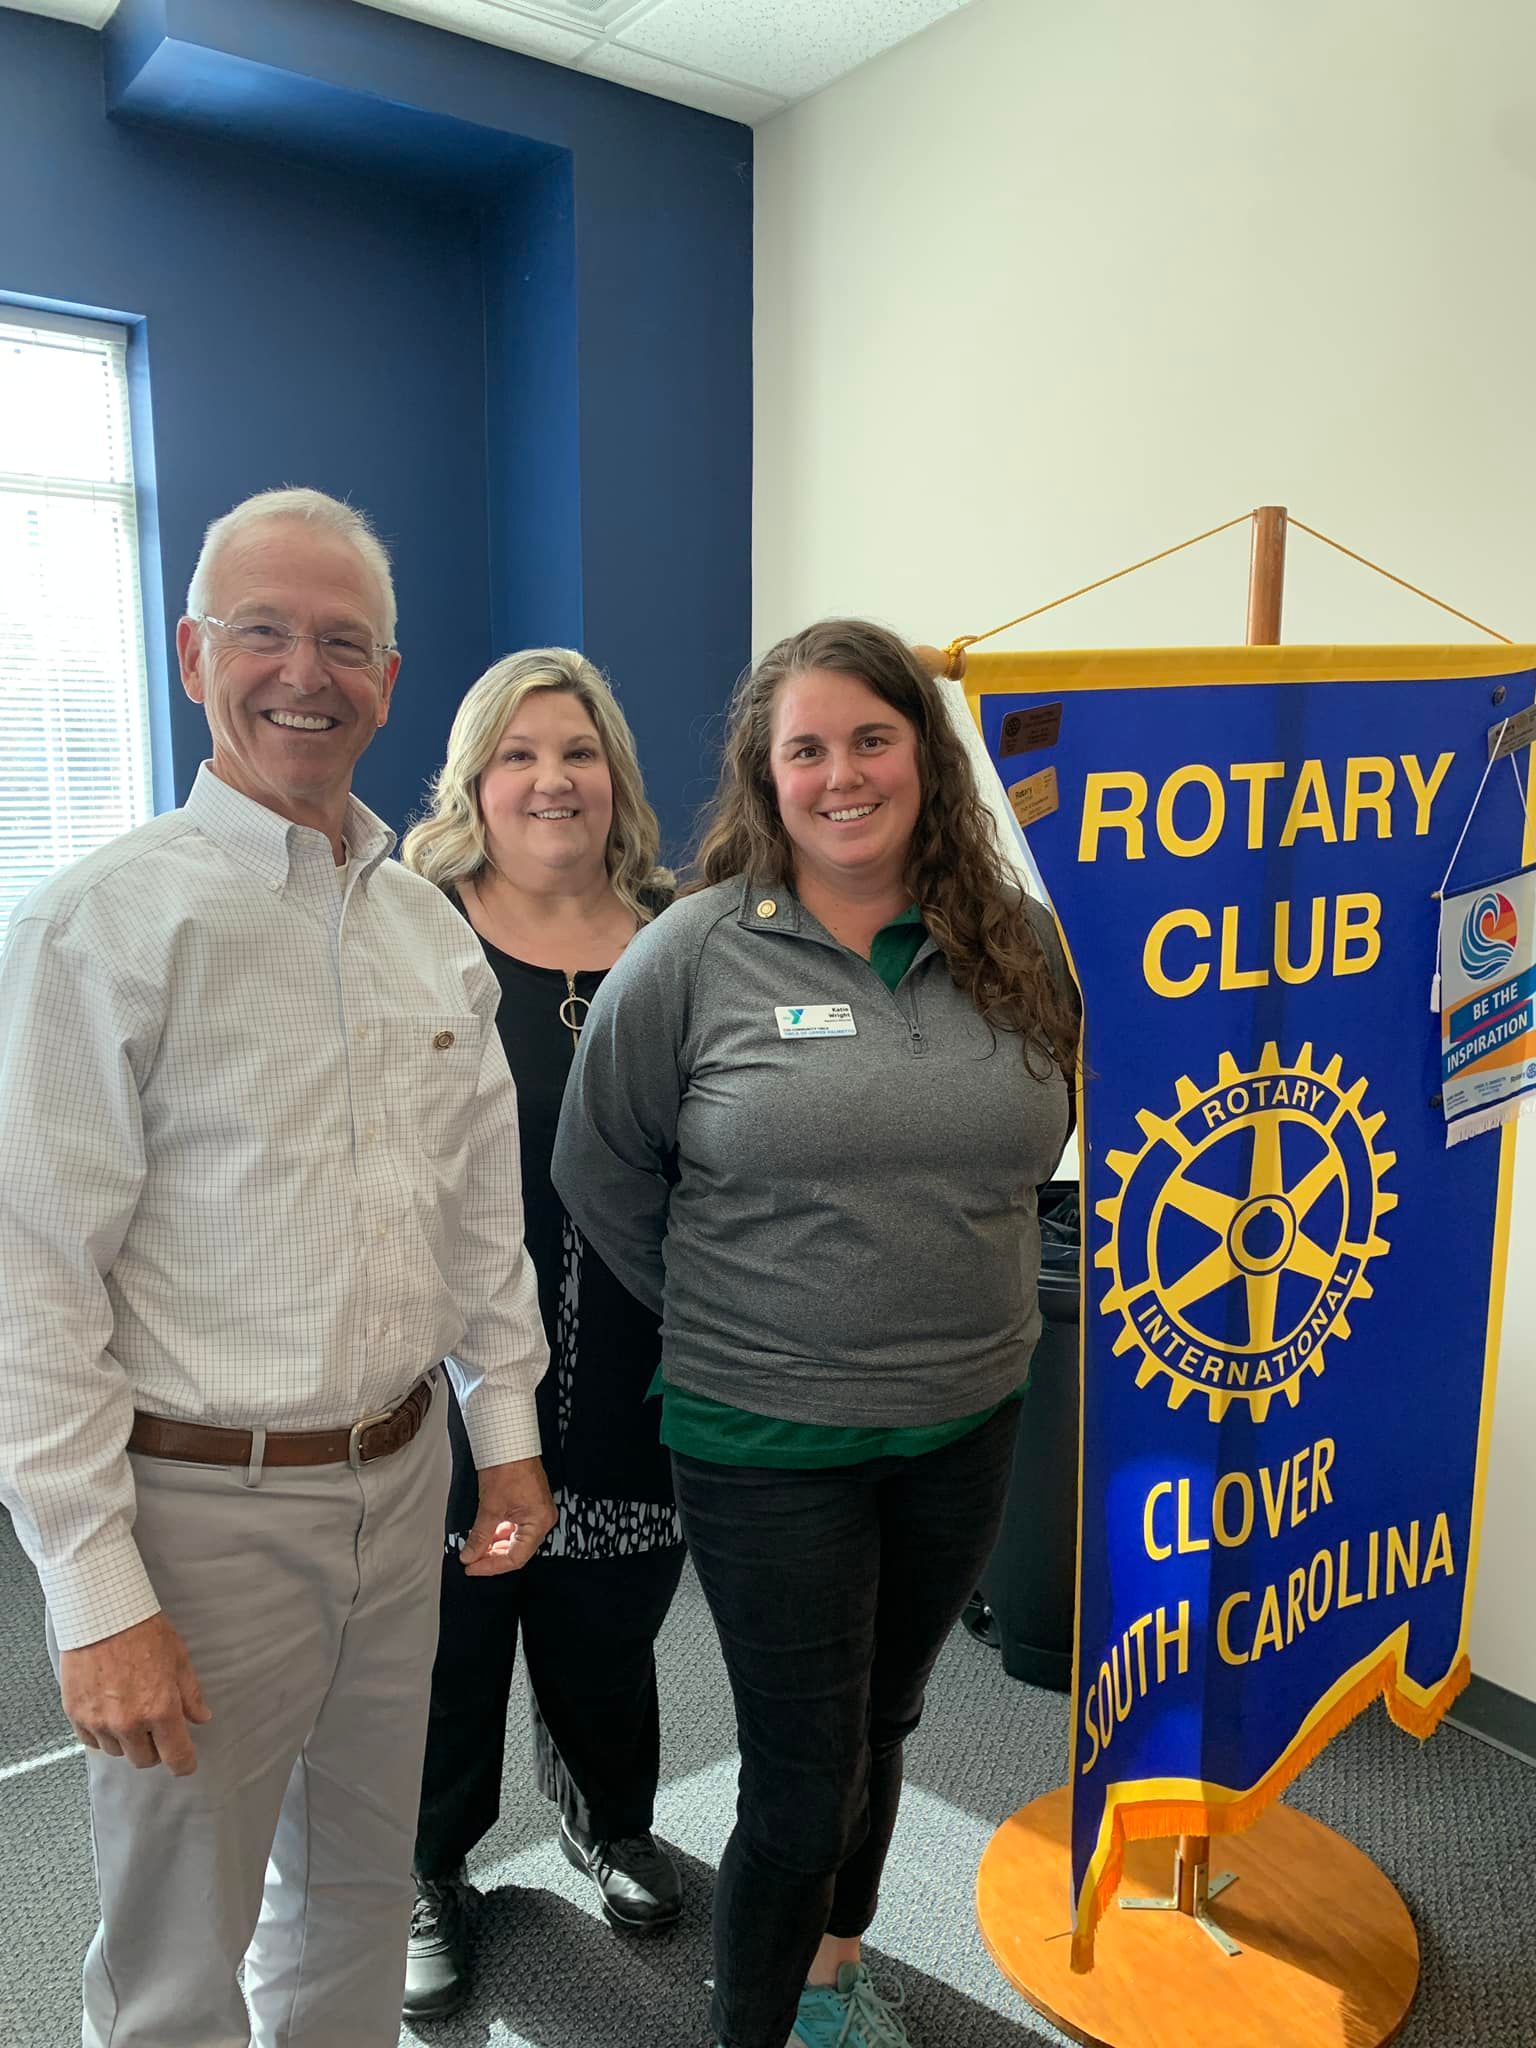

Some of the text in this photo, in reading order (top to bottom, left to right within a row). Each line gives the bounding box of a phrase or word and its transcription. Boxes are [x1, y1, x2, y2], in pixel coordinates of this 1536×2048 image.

[1078, 752, 1455, 863] ROTARY
[1143, 892, 1382, 999] CLUB
[1447, 1011, 1527, 1073] INSPIRATION
[1473, 982, 1518, 1020] BE THE
[1202, 1079, 1325, 1128] ROTARY
[1138, 1267, 1355, 1386] INTERNATIONAL
[1143, 1438, 1335, 1561] CLOVER
[1081, 1512, 1455, 1775] SOUTH CAROLINA
